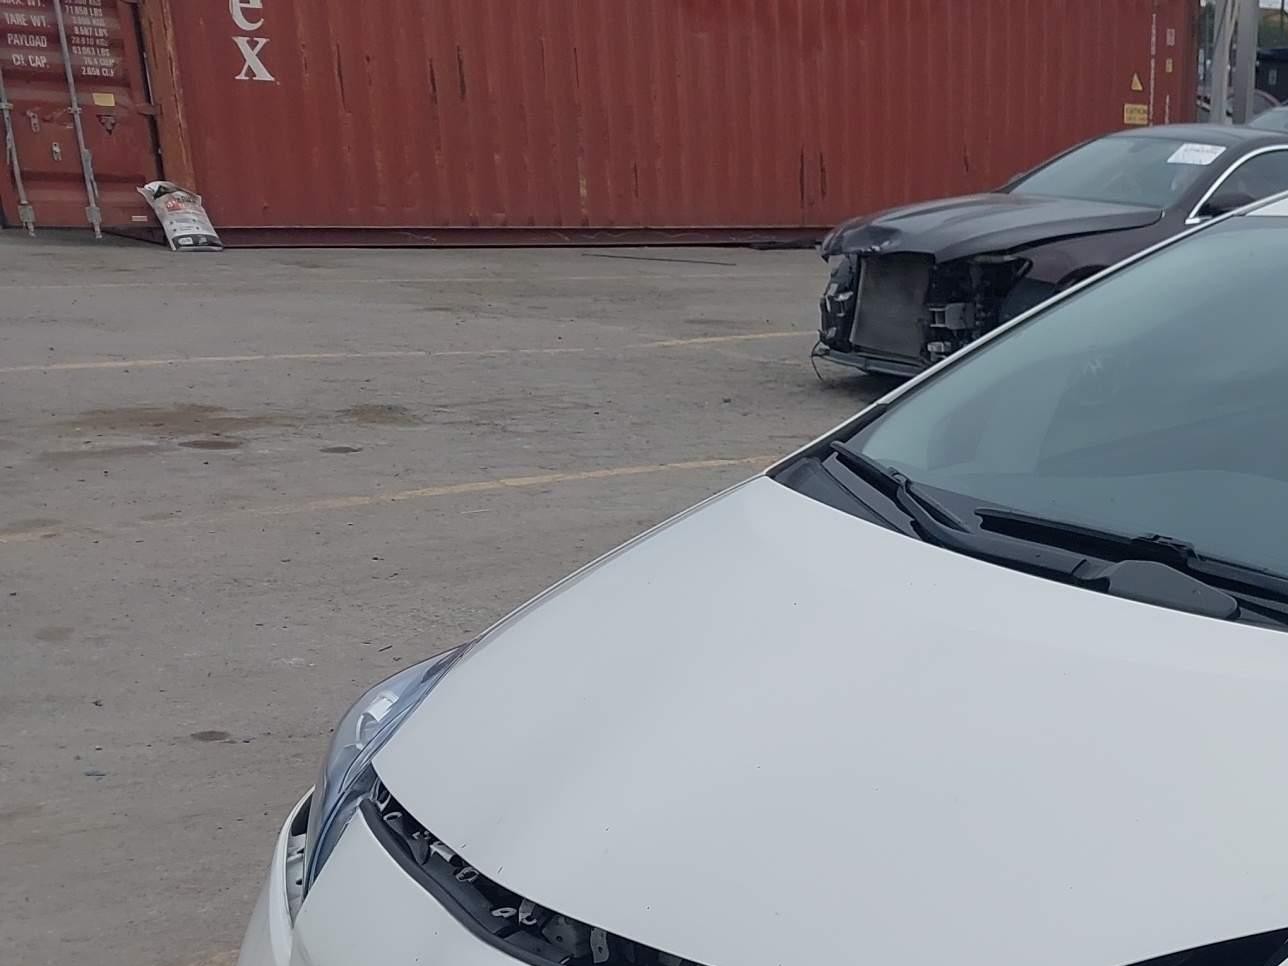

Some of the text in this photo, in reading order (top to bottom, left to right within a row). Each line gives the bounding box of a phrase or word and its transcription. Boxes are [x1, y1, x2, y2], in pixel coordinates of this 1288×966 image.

[4, 12, 28, 26] TARE
[8, 33, 47, 48] PAYLOAD
[28, 55, 50, 68] CAP.
